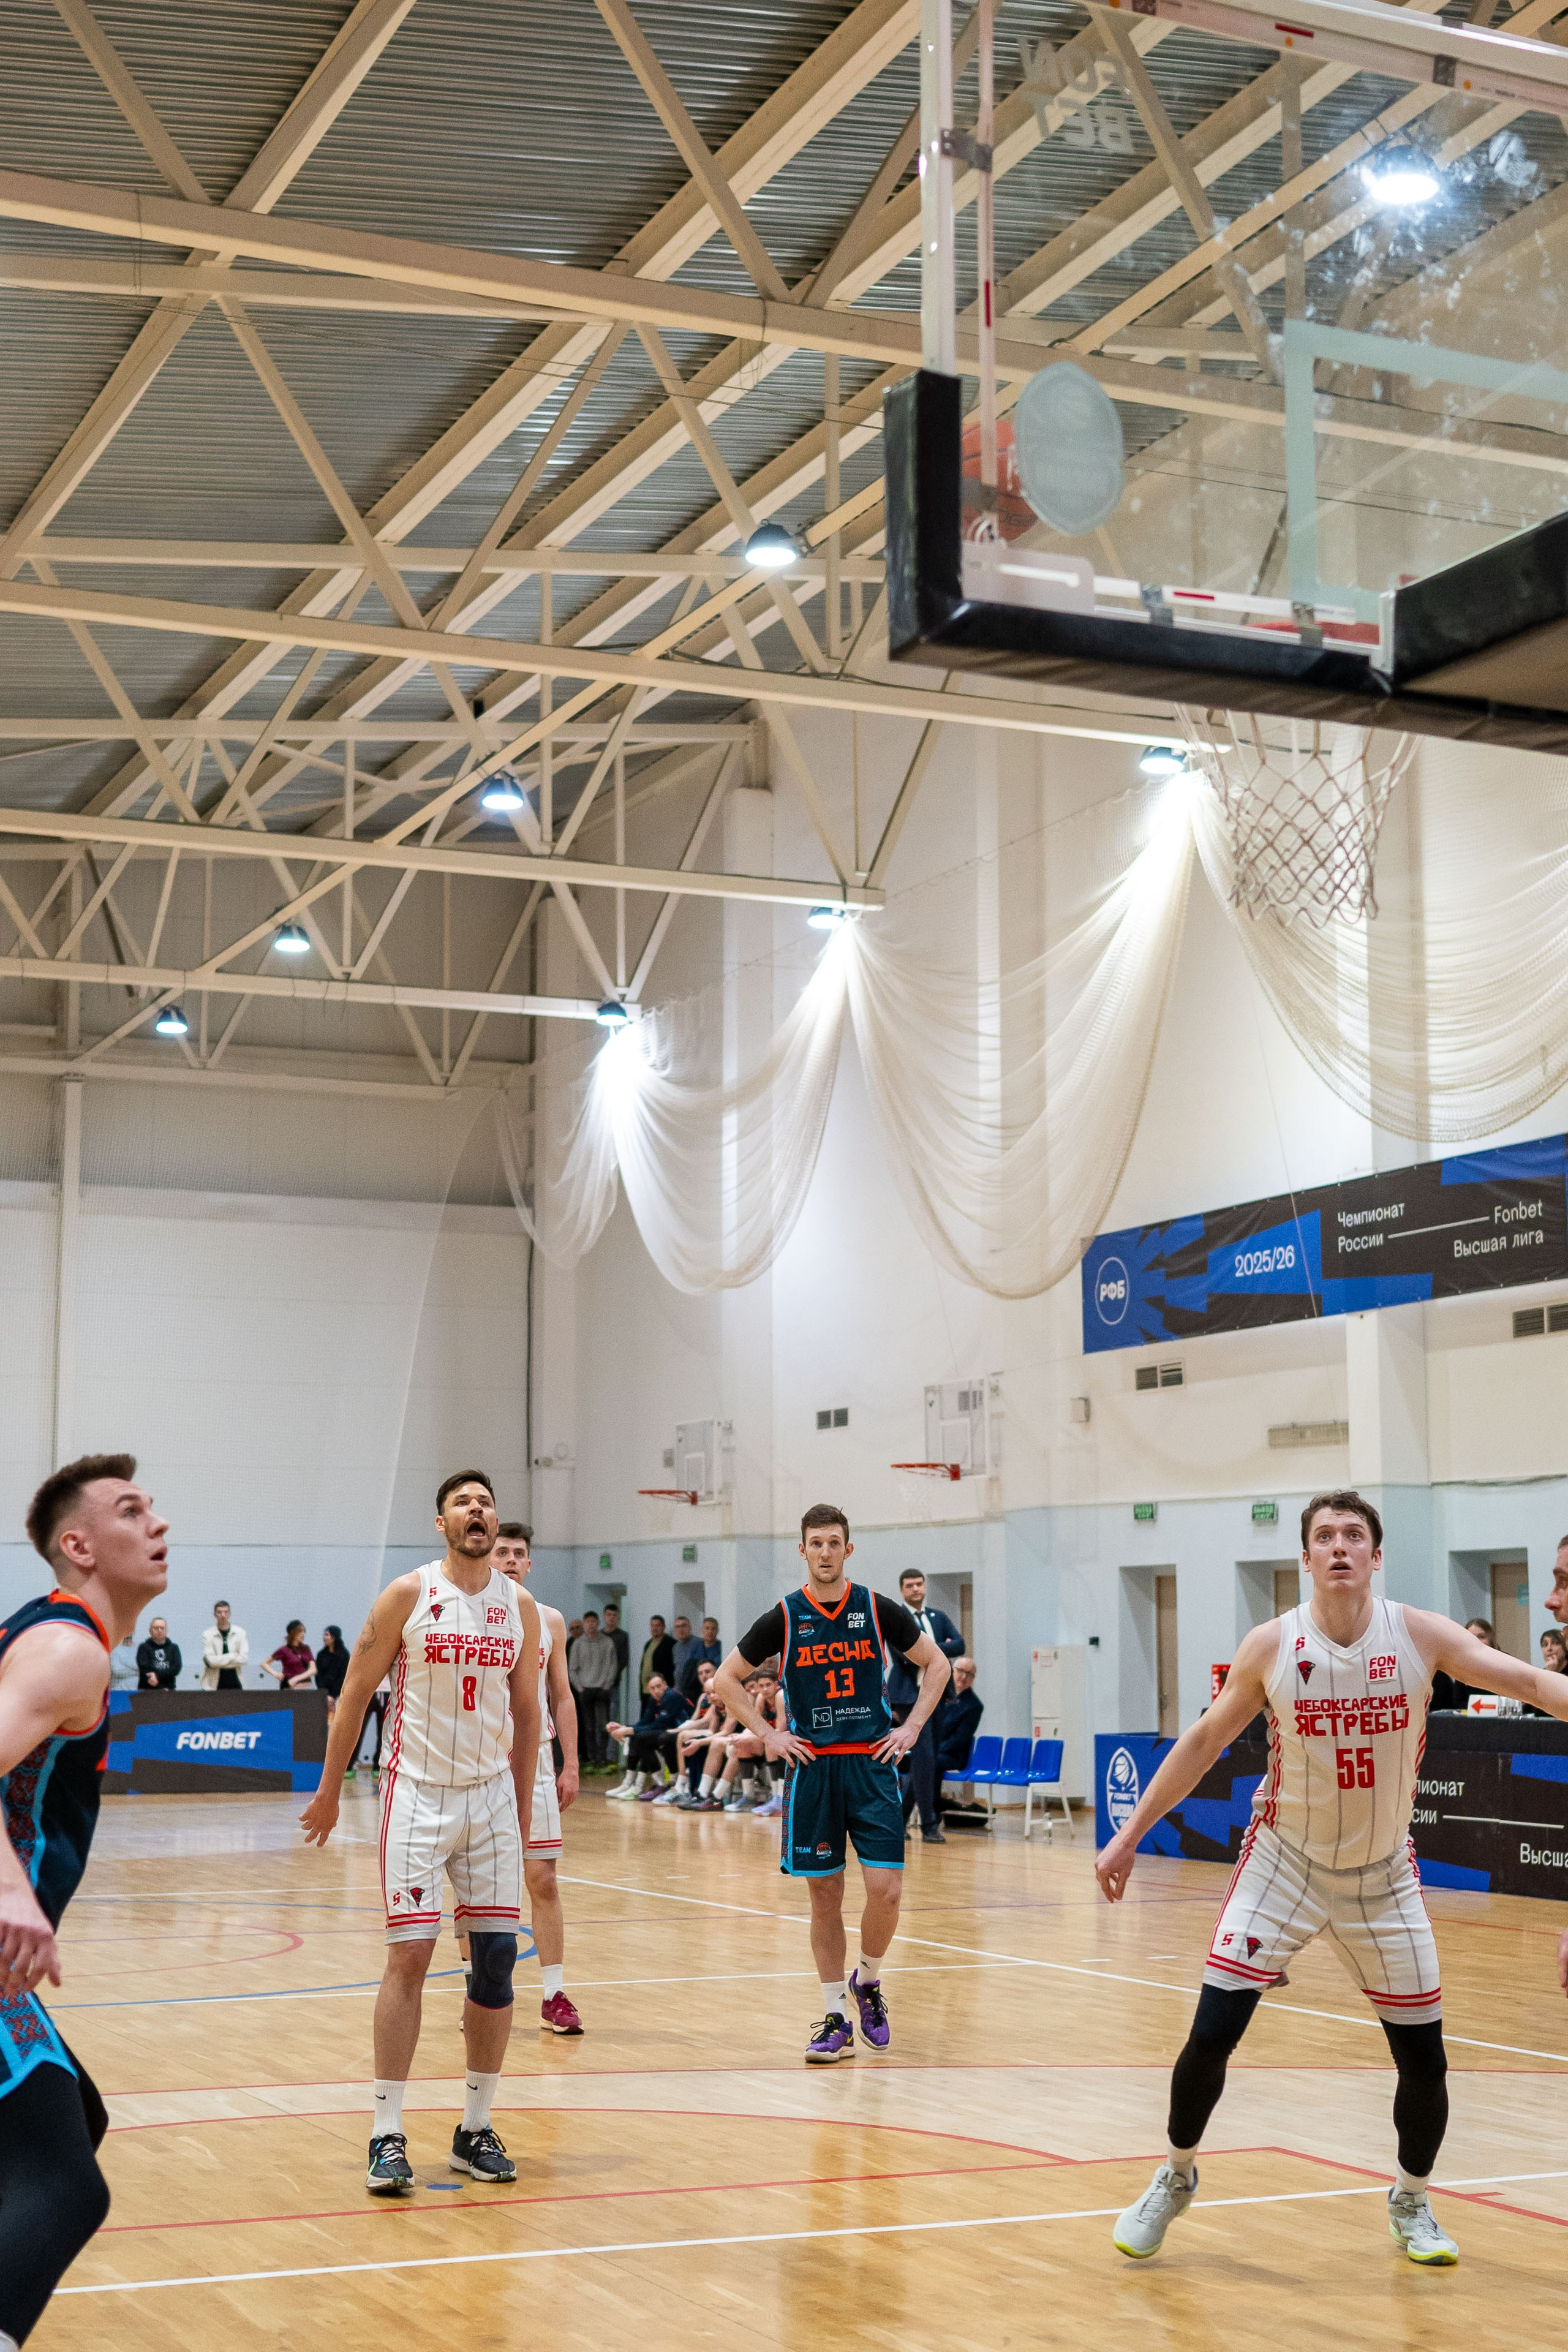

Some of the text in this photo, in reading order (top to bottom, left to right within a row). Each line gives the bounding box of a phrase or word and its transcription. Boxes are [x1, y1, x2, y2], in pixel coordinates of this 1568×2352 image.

[1337, 1202, 1405, 1227] Чемпионат
[1494, 1199, 1544, 1224] Fonbet
[1338, 1233, 1384, 1254] России
[1453, 1229, 1544, 1257] Высшая лига
[1235, 1245, 1295, 1278] 2025/26
[1099, 1280, 1125, 1303] РФБ
[486, 1616, 506, 1624] BET
[487, 1607, 507, 1617] FON
[847, 1612, 865, 1621] FON
[848, 1620, 866, 1629] BET
[425, 1634, 515, 1651] ЧЕБОКСАРСКИЕ
[796, 1640, 875, 1667] ДЕСНА
[424, 1645, 515, 1669] ЯСТРЕБЫ
[1370, 1655, 1396, 1669] FON
[824, 1668, 855, 1698] 13
[1369, 1667, 1396, 1680] BET
[462, 1676, 477, 1711] 8
[1294, 1694, 1408, 1713] ЧЕБОКСАРСКИЕ
[1294, 1708, 1409, 1737] ЯСТРЕБЫ
[176, 1732, 262, 1750] FONBET
[1336, 1747, 1375, 1789] 55
